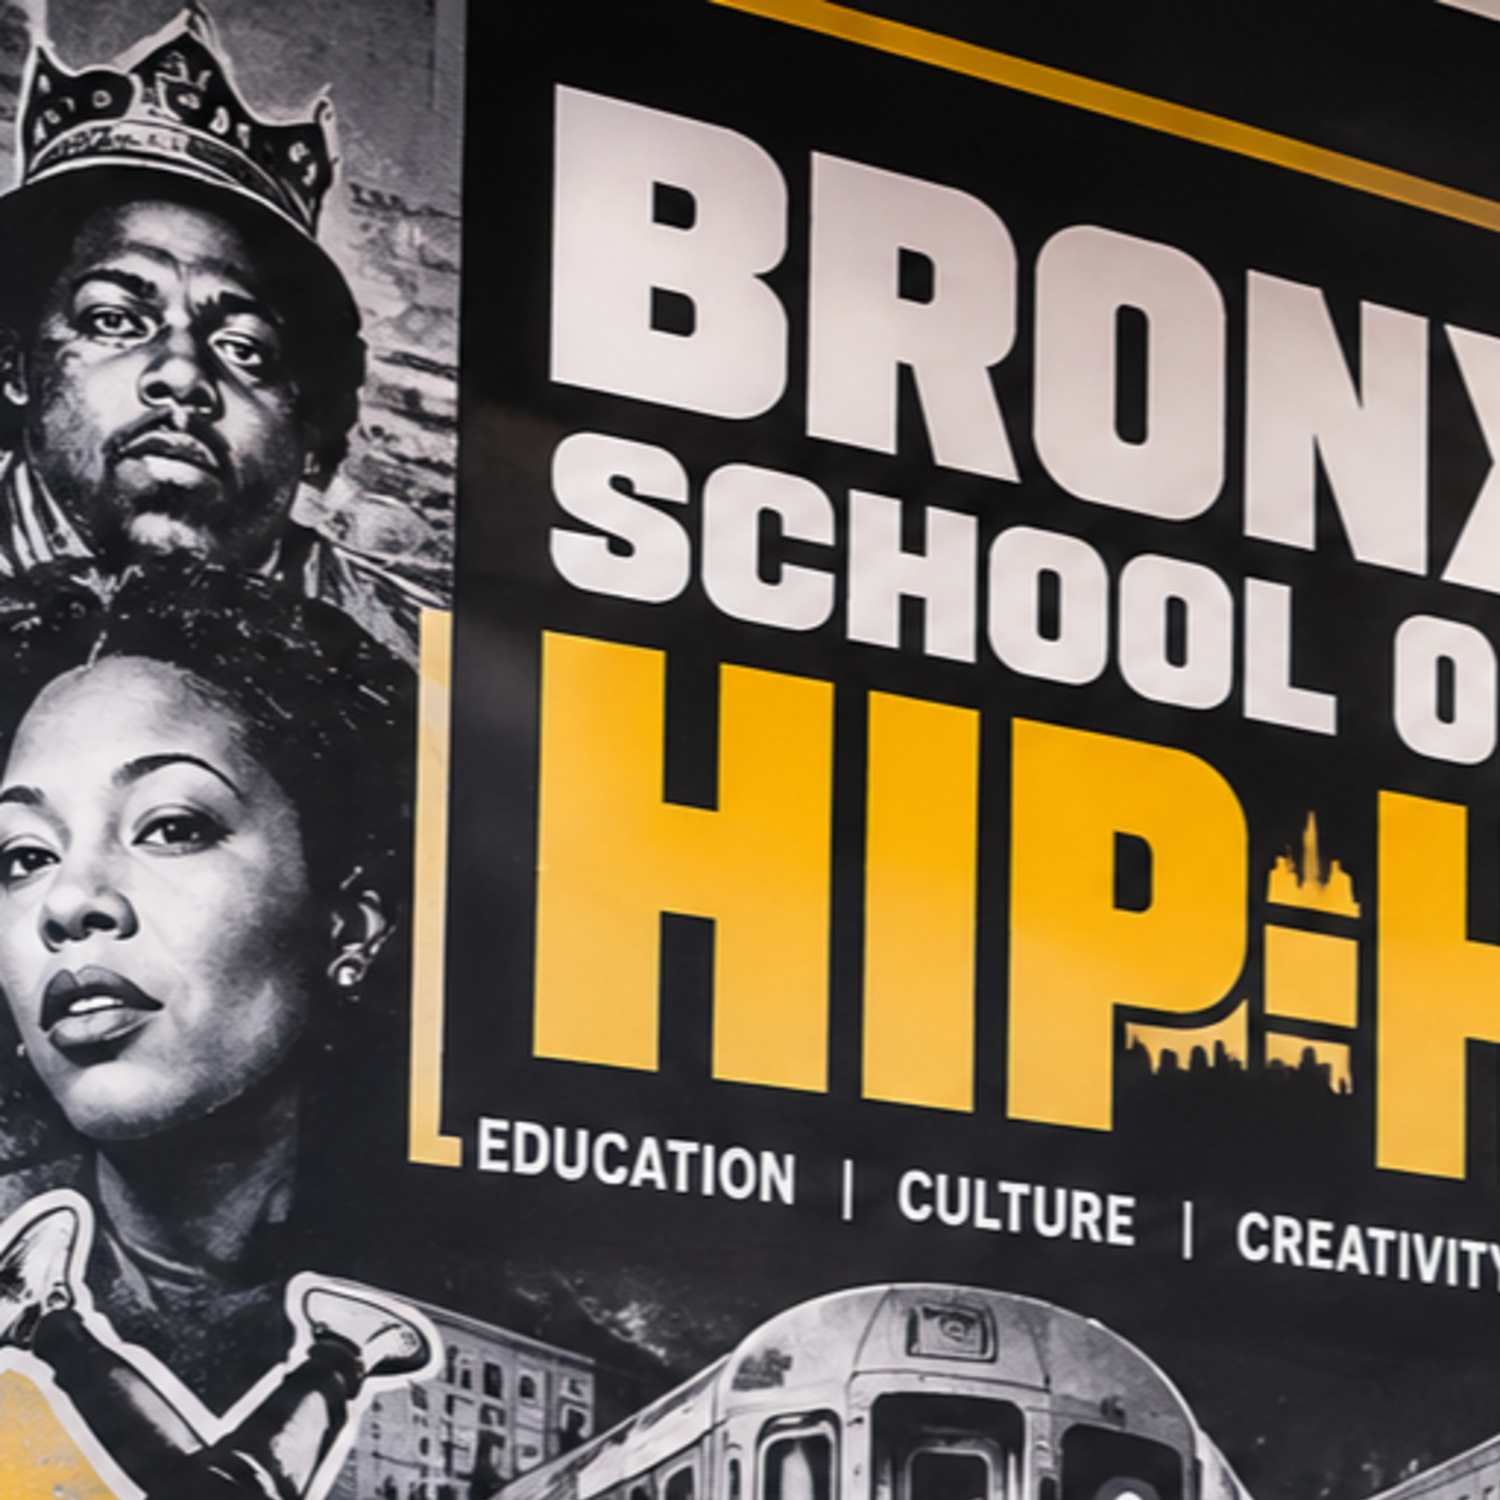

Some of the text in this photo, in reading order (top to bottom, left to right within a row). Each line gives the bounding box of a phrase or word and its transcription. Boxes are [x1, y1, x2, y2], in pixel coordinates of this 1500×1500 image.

[550, 431, 1336, 736] SCHOOL
[476, 1117, 796, 1206] EDUCATION
[898, 1169, 1136, 1246] CULTURE
